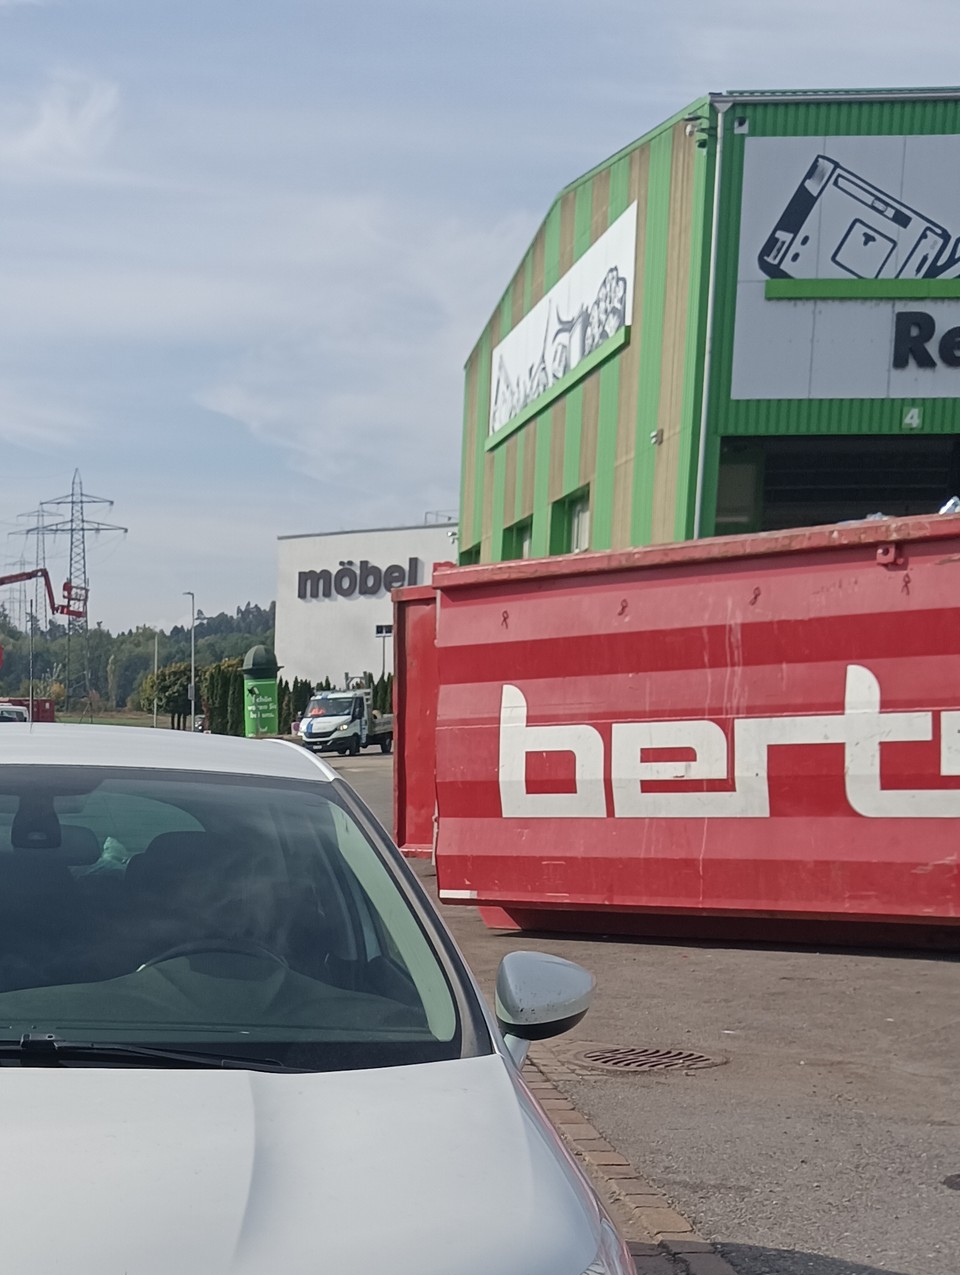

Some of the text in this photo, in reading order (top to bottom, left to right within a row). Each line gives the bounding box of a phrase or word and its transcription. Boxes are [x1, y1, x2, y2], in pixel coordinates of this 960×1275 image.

[903, 407, 920, 429] 4
[297, 557, 418, 599] möbel
[499, 664, 960, 818] bert
